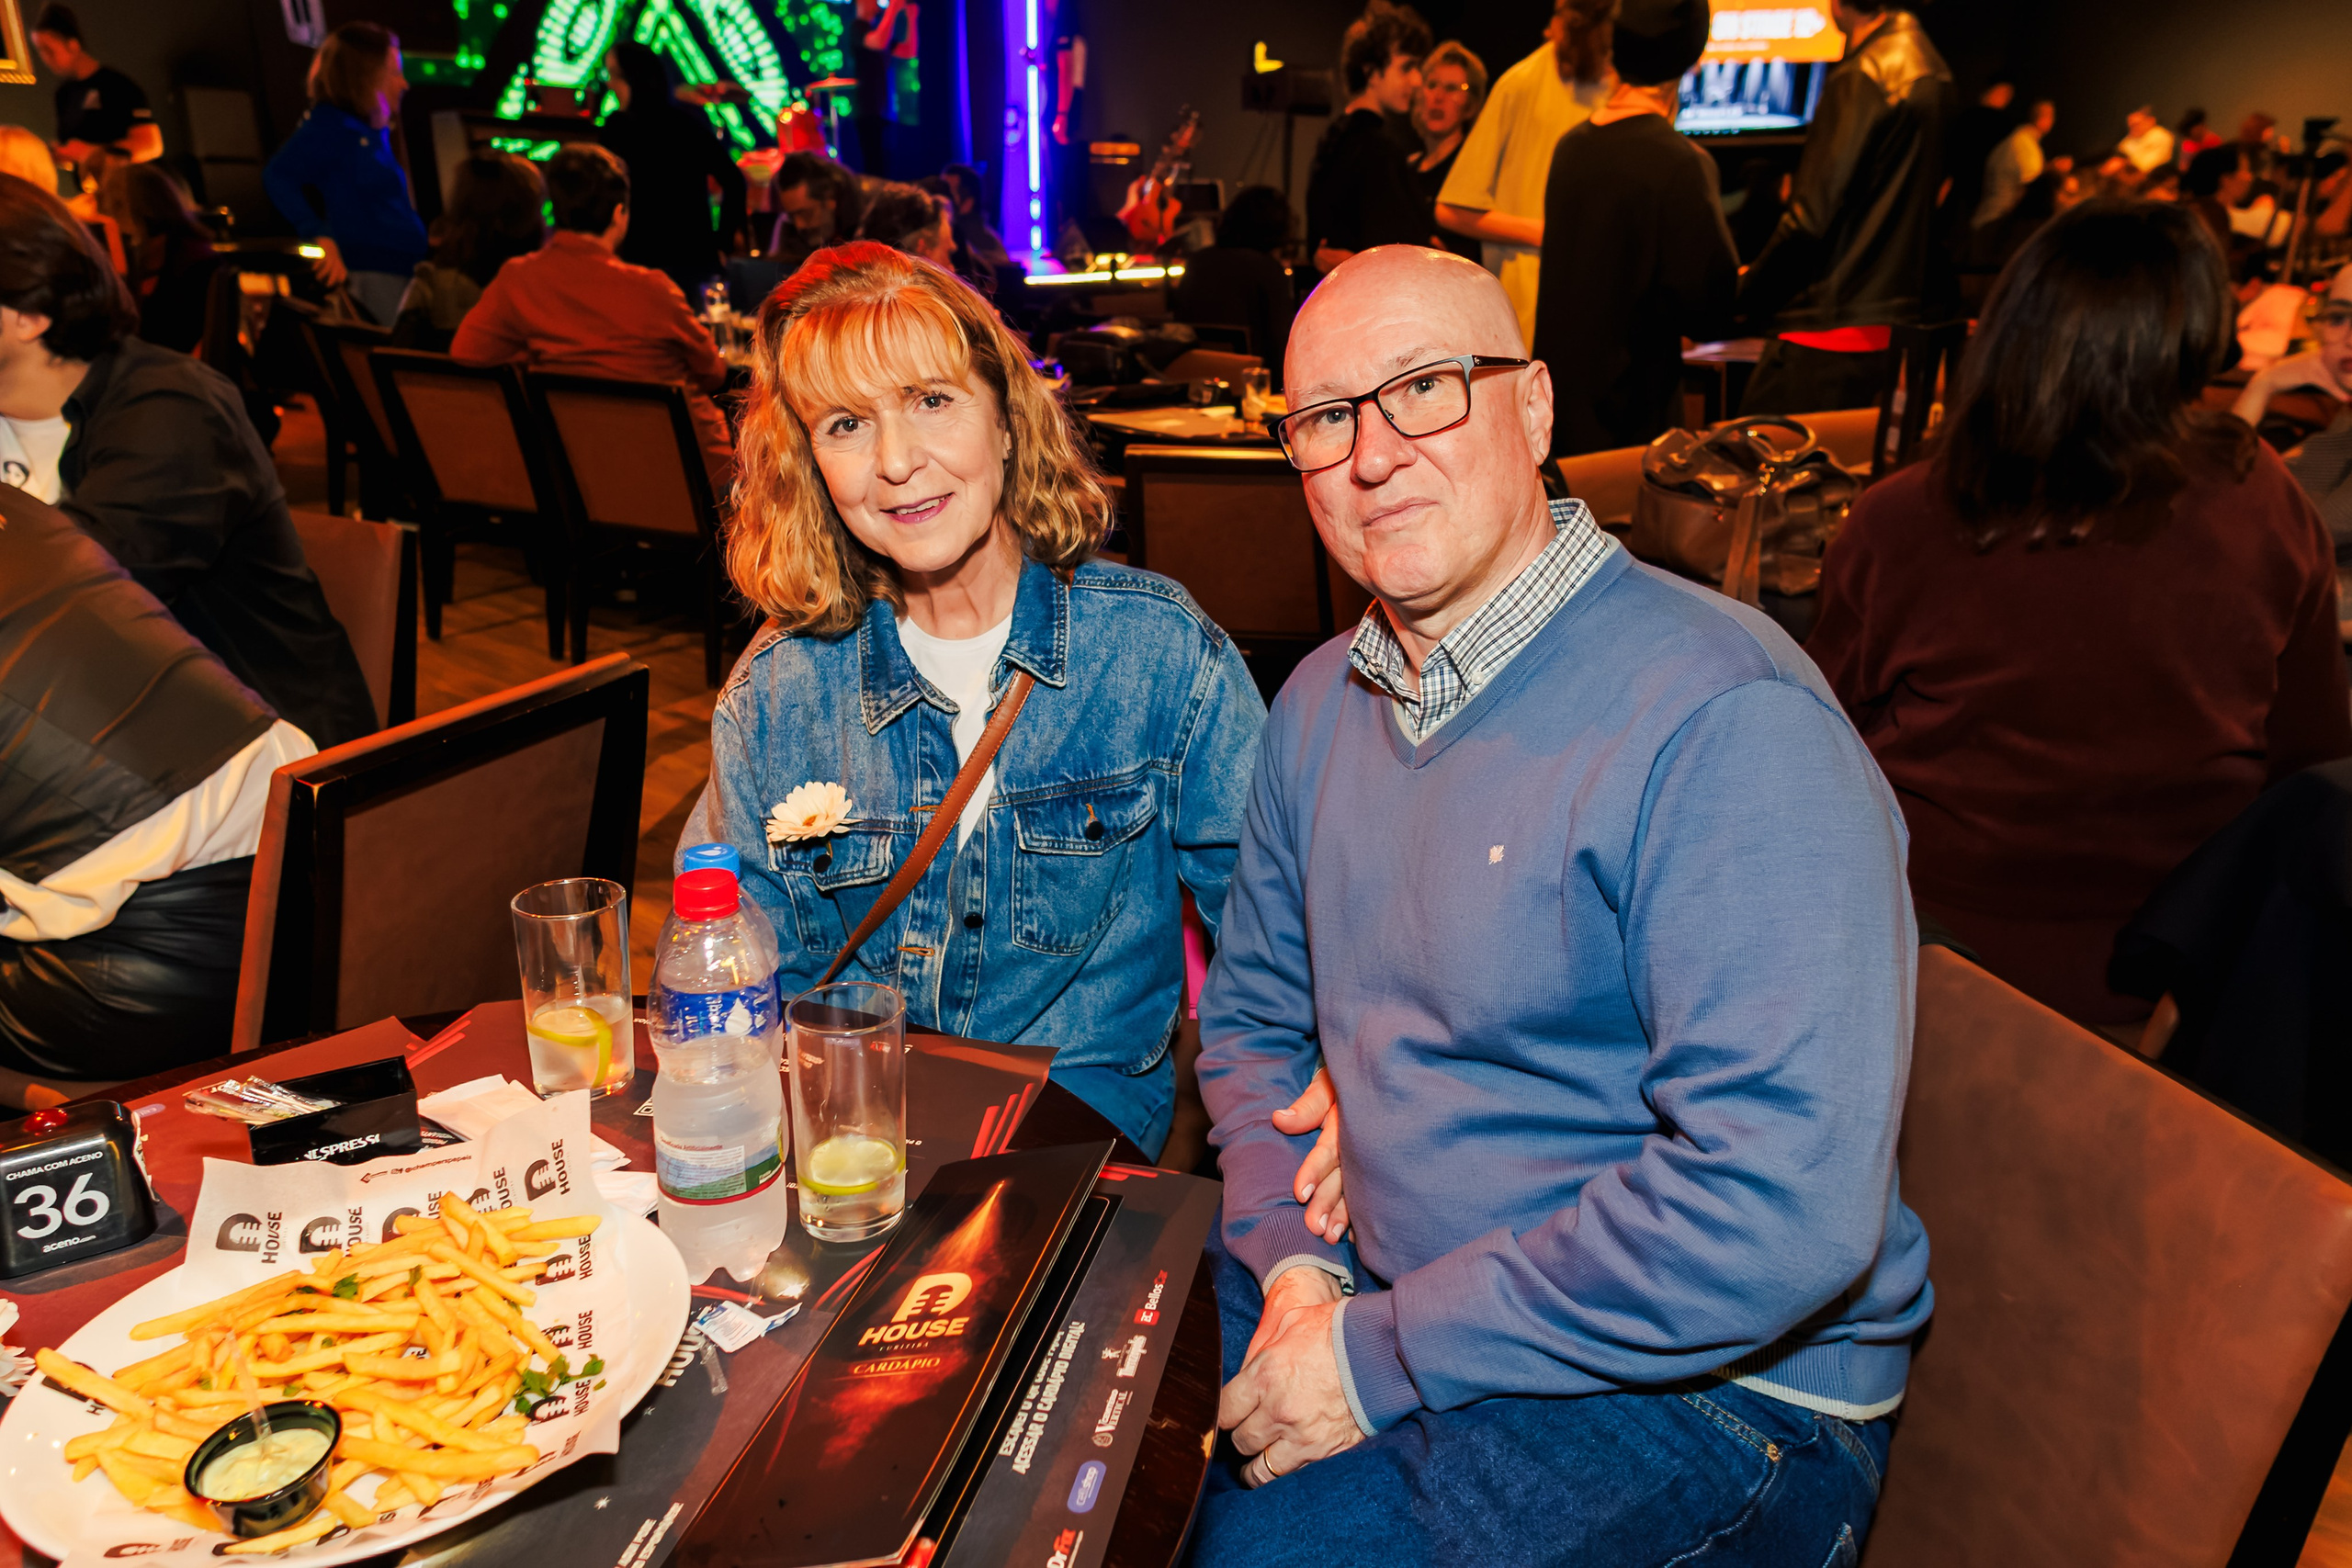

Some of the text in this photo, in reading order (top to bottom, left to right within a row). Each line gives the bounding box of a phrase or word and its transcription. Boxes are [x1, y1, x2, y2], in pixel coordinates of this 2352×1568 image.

[6, 1151, 104, 1181] CHAMA COM ACENO
[551, 1138, 571, 1195] HOUSE
[14, 1172, 110, 1239] 36
[493, 1167, 513, 1210] OUSE
[261, 1212, 283, 1264] HOUSE
[345, 1206, 364, 1257] OUSE
[578, 1234, 594, 1280] HOUSE
[577, 1309, 594, 1350] HOUSE
[656, 1304, 714, 1387] HOU
[858, 1316, 970, 1347] HOUSE
[879, 1340, 930, 1352] CURITIBA
[854, 1357, 941, 1375] CARDÁPIO
[1036, 1359, 1069, 1412] CARDÁPIO
[573, 1379, 592, 1417] HOUSE
[1033, 1412, 1048, 1423] O
[1012, 1422, 1045, 1475] ACESSAR
